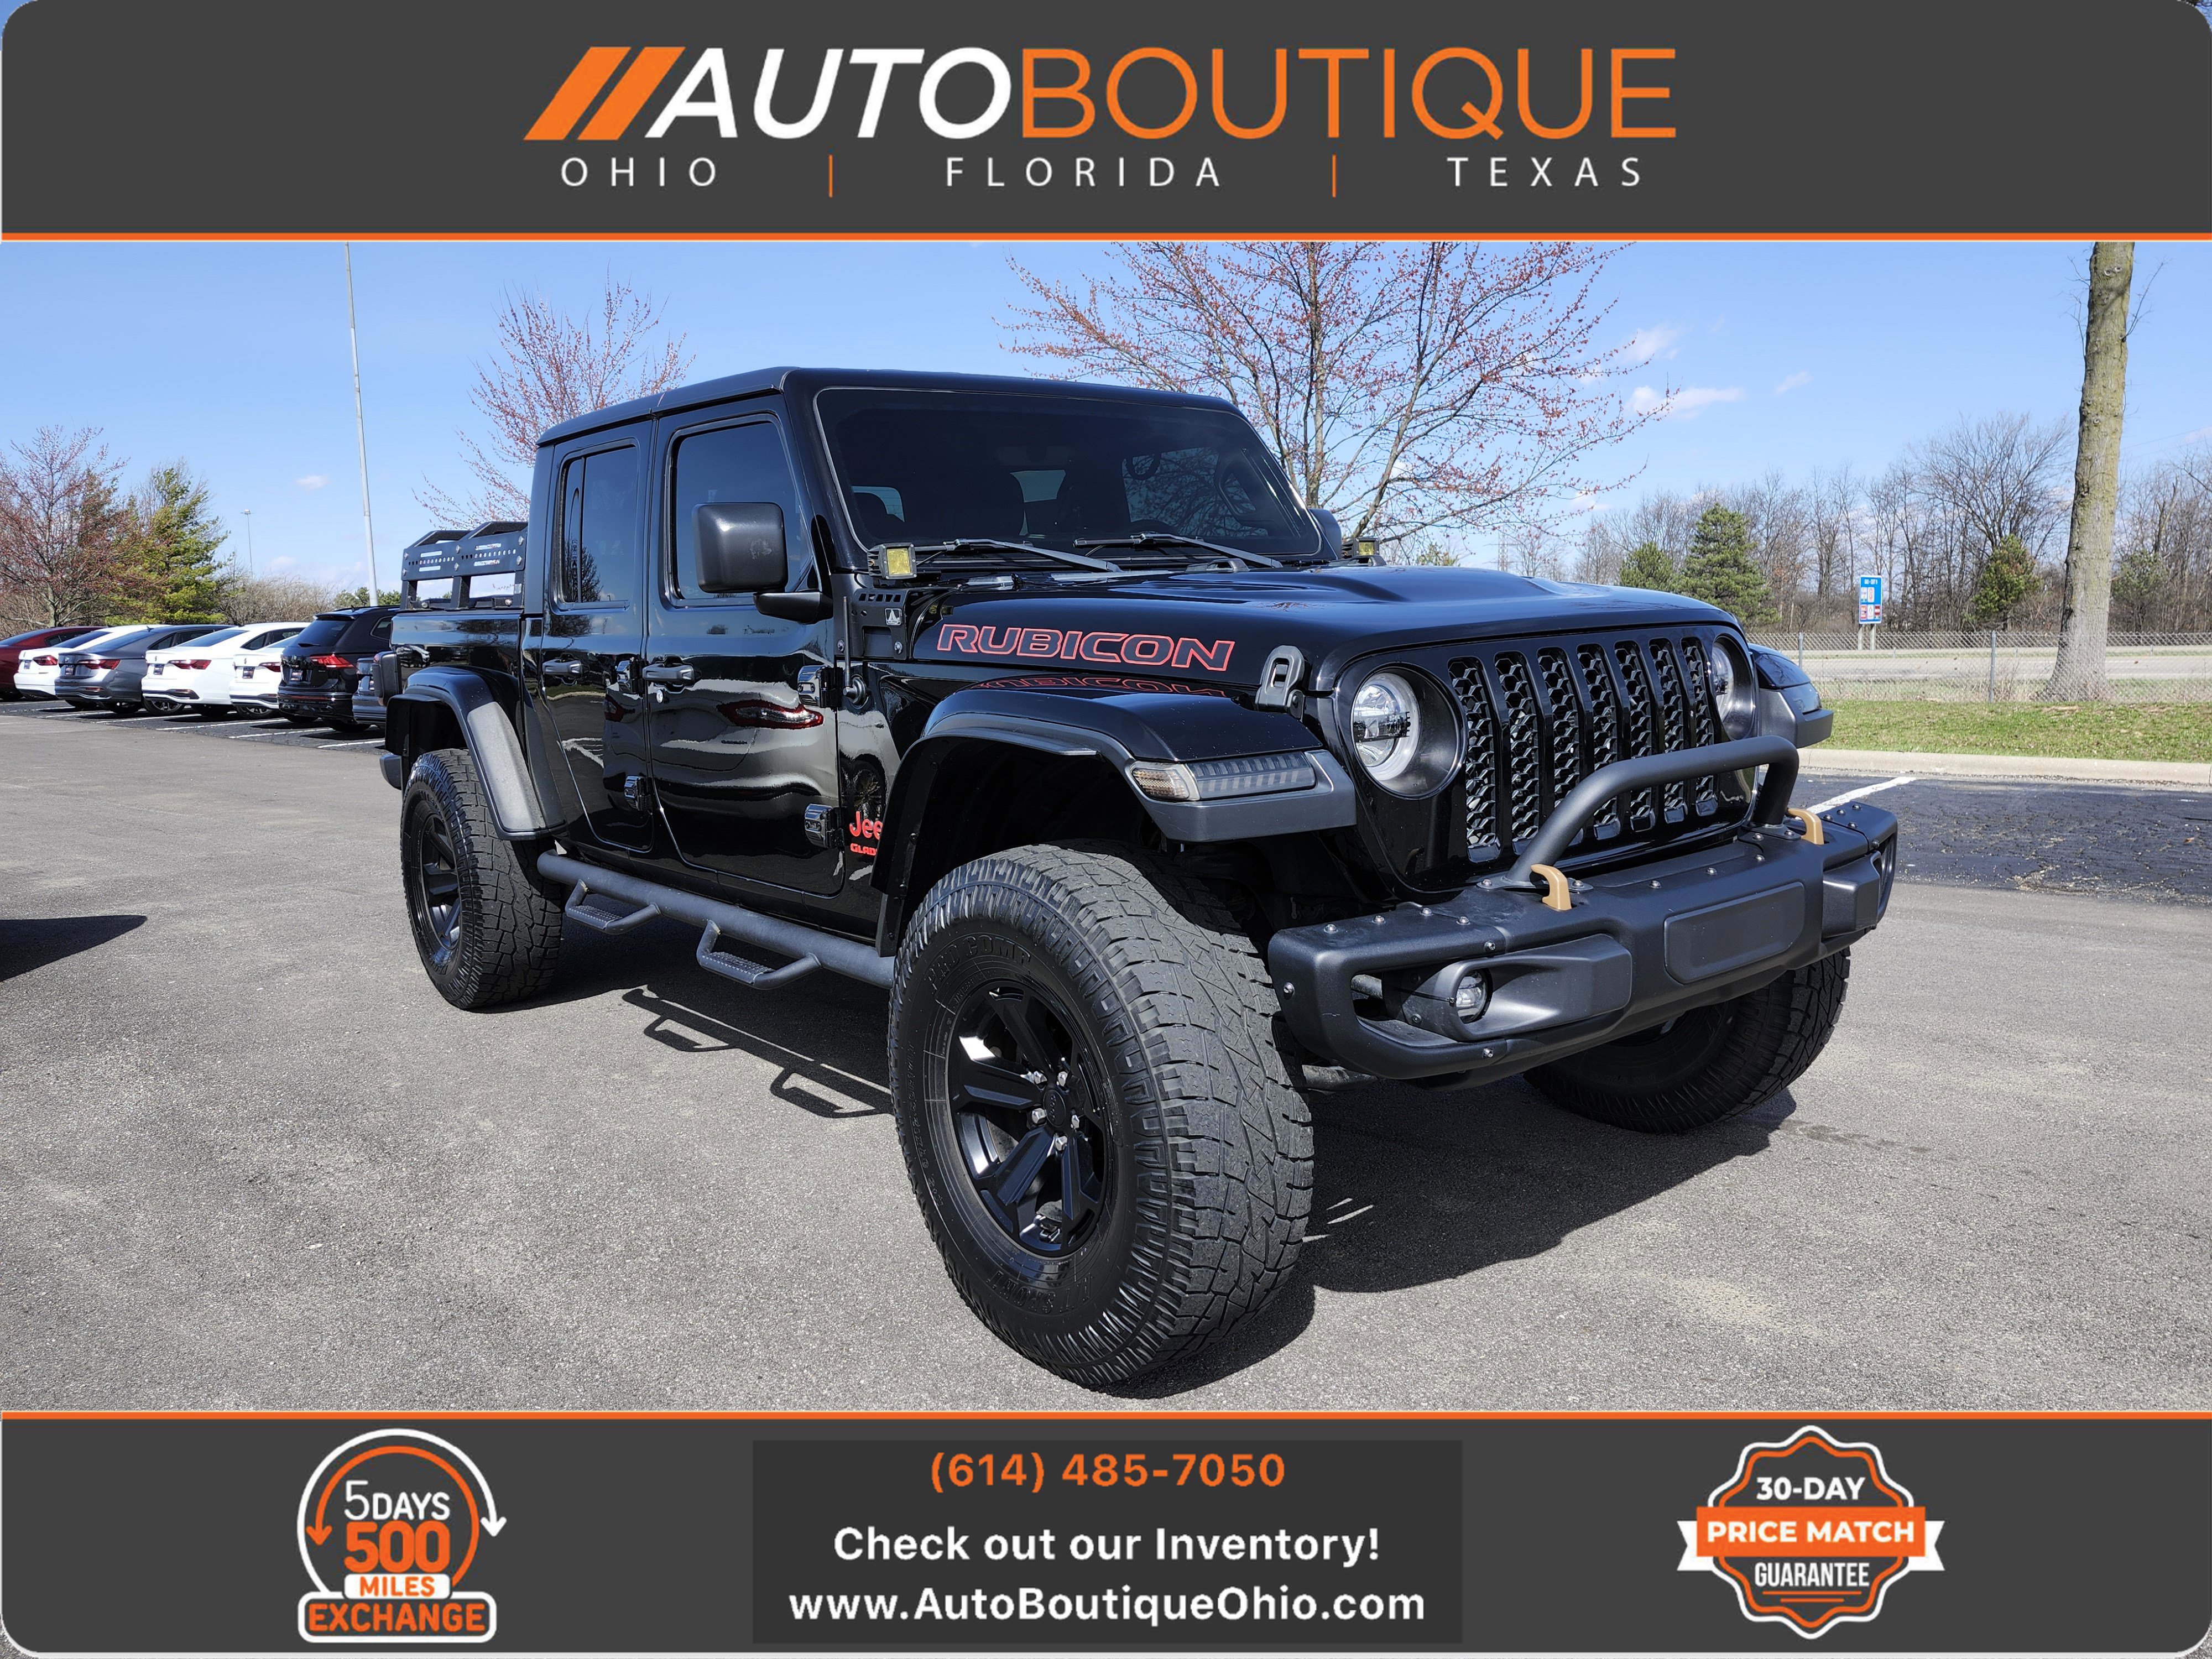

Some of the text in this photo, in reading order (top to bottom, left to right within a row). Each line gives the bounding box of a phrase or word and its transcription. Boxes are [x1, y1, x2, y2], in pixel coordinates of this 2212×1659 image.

[937, 624, 1235, 671] RUBICON
[850, 843, 878, 856] GLAD
[963, 935, 1032, 964] COMP
